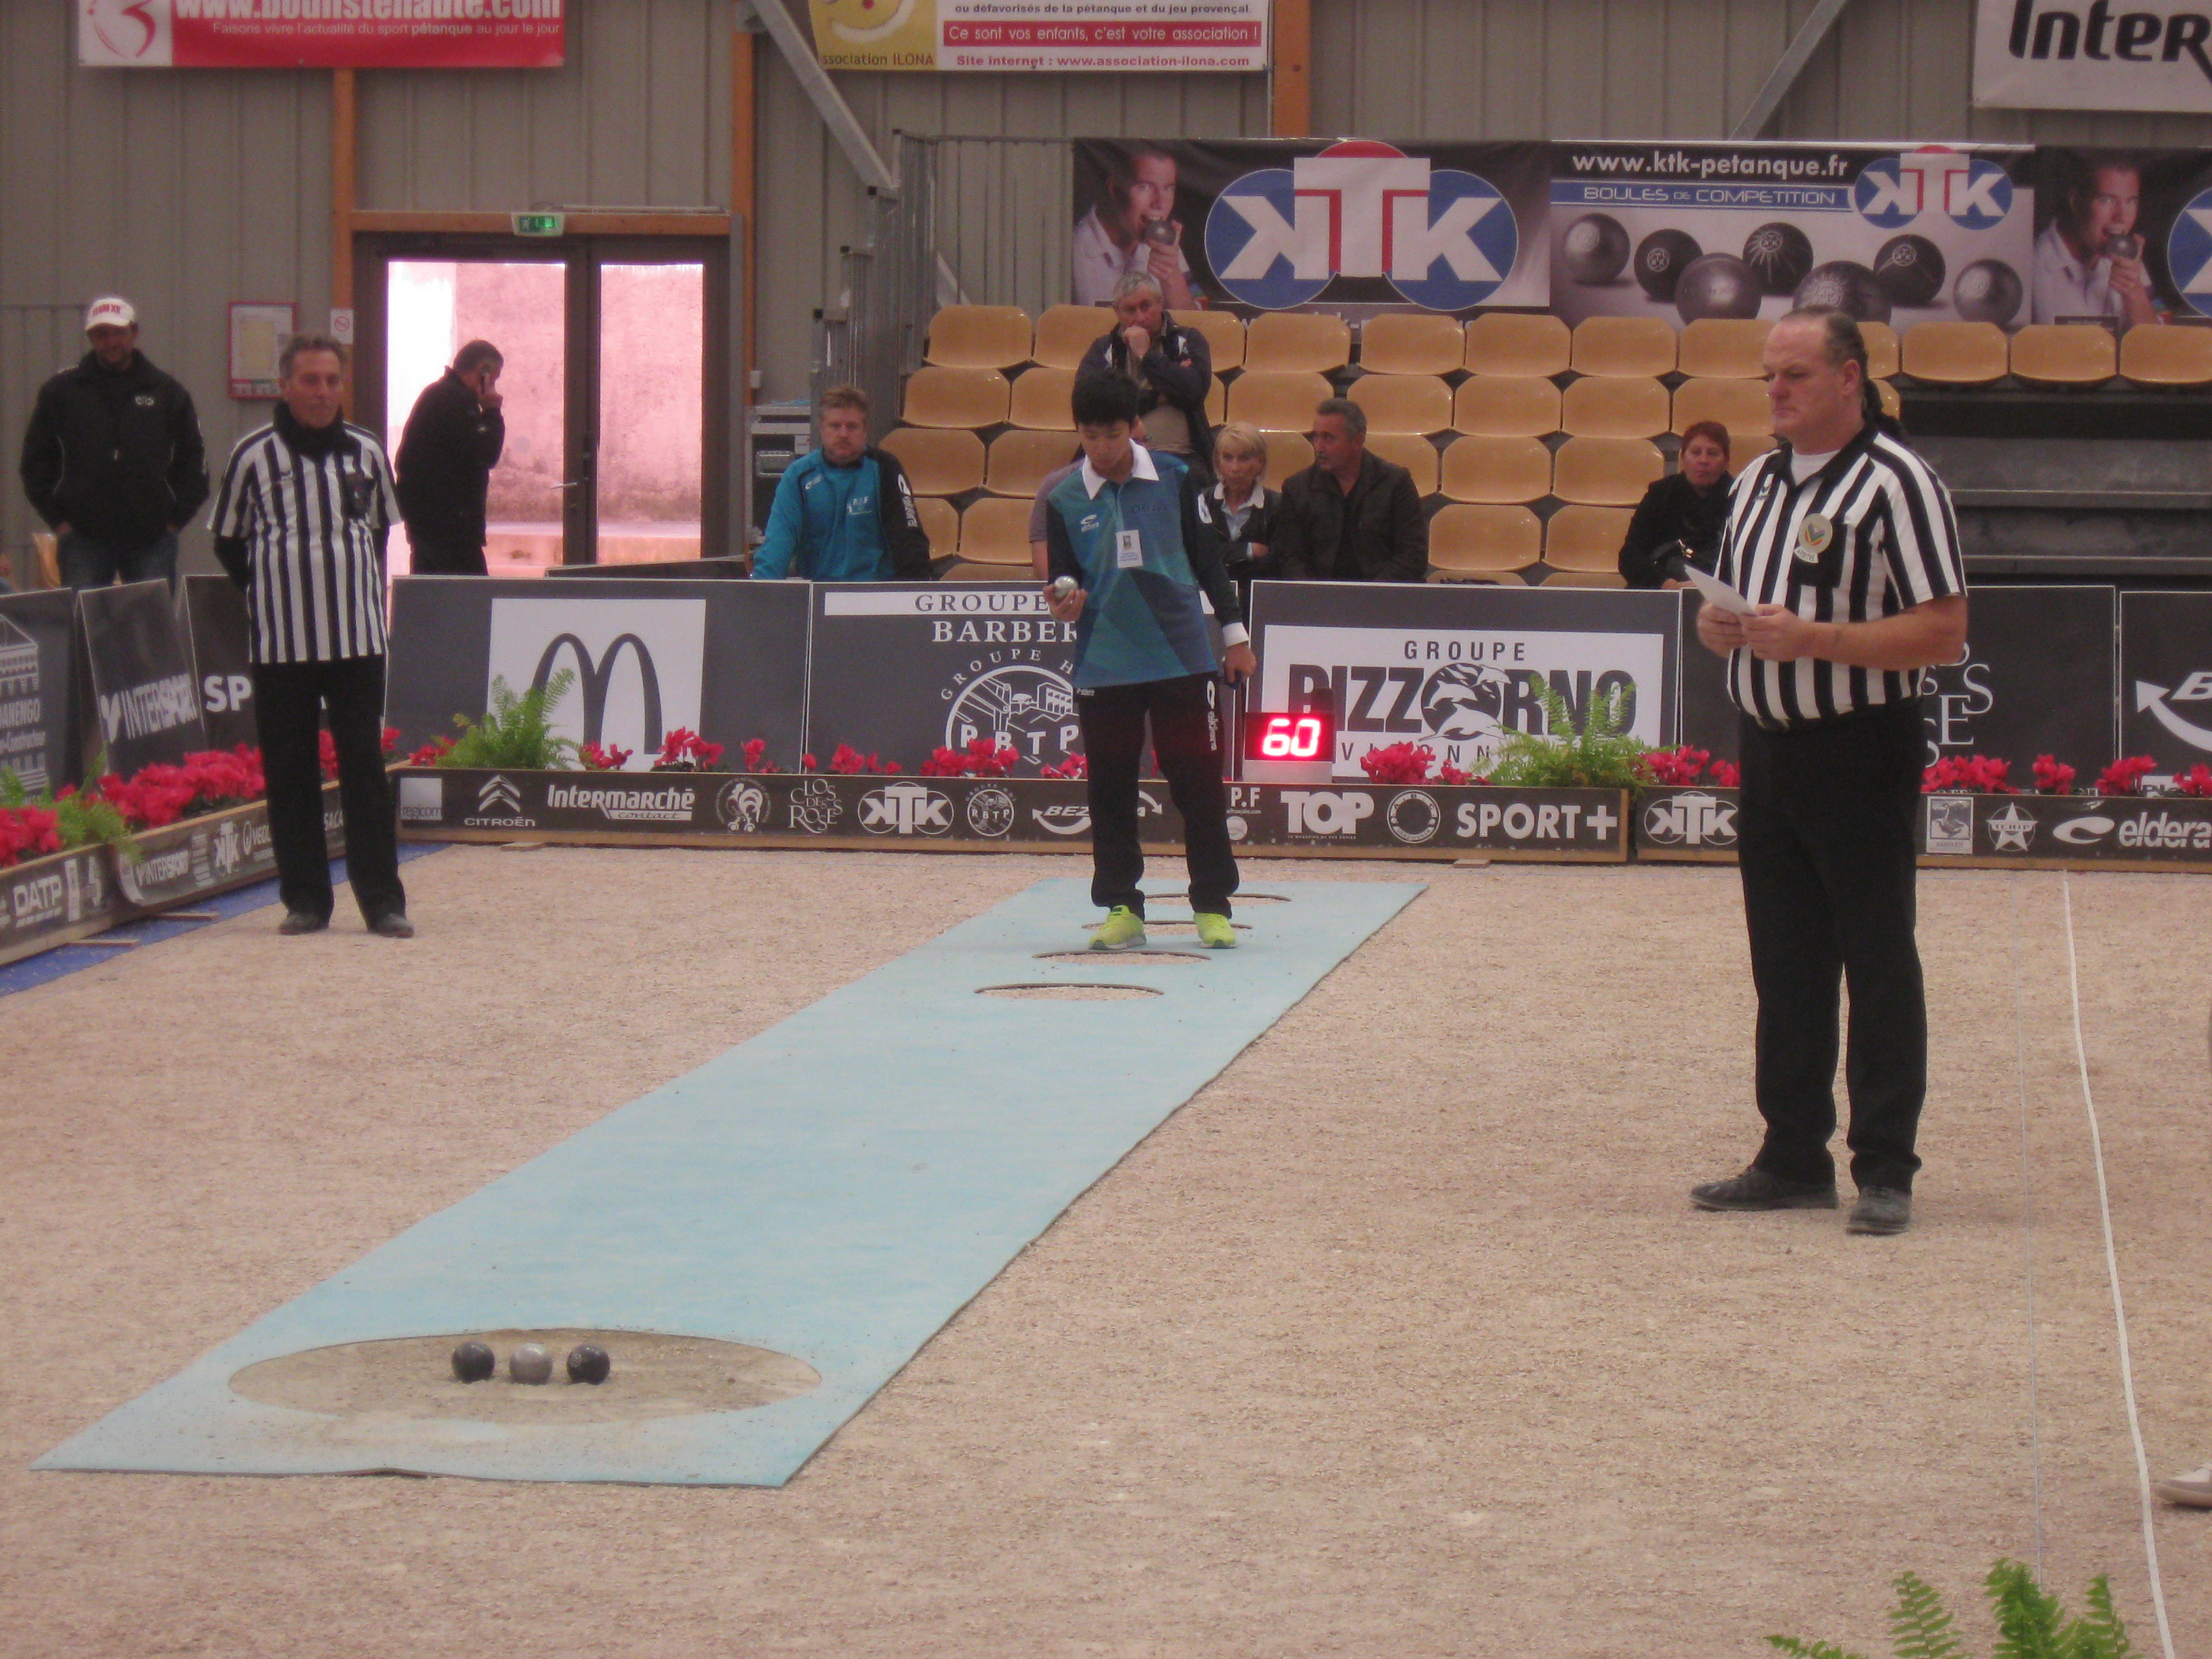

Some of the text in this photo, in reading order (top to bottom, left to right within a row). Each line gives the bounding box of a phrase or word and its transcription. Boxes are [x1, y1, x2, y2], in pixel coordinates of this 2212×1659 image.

[974, 4, 1041, 13] défavorisés
[1045, 5, 1058, 13] de
[1063, 5, 1073, 13] la
[1077, 4, 1132, 15] pétanque
[1136, 5, 1147, 13] et
[1151, 5, 1165, 13] du
[1168, 5, 1187, 15] jeu
[213, 22, 560, 36] Faisons vivre l'actualité du sport pétanque au jour le jour
[949, 27, 968, 40] Ce
[975, 28, 1002, 40] sont
[1008, 30, 1030, 40] vos
[1037, 27, 1088, 41] enfants,
[1094, 27, 1126, 40] c'est
[1132, 28, 1166, 40] votre
[1172, 27, 1248, 40] association
[822, 53, 933, 66] ssociation ILONA
[957, 55, 983, 66] Site
[989, 55, 1044, 66] internet
[1057, 56, 1249, 66] www.association-ilona.com
[1572, 150, 1848, 180] www.ktk-petanque.fr
[1584, 186, 1835, 205] BOULES DE COMPETITION
[1220, 157, 1503, 281] KTK
[915, 594, 1050, 611] GROUPE
[1404, 640, 1525, 661] GROUPE
[941, 648, 1042, 701] GROUPE
[1263, 719, 1321, 756] 60
[1280, 791, 1375, 834] TOP
[1456, 802, 1581, 840] SPORT
